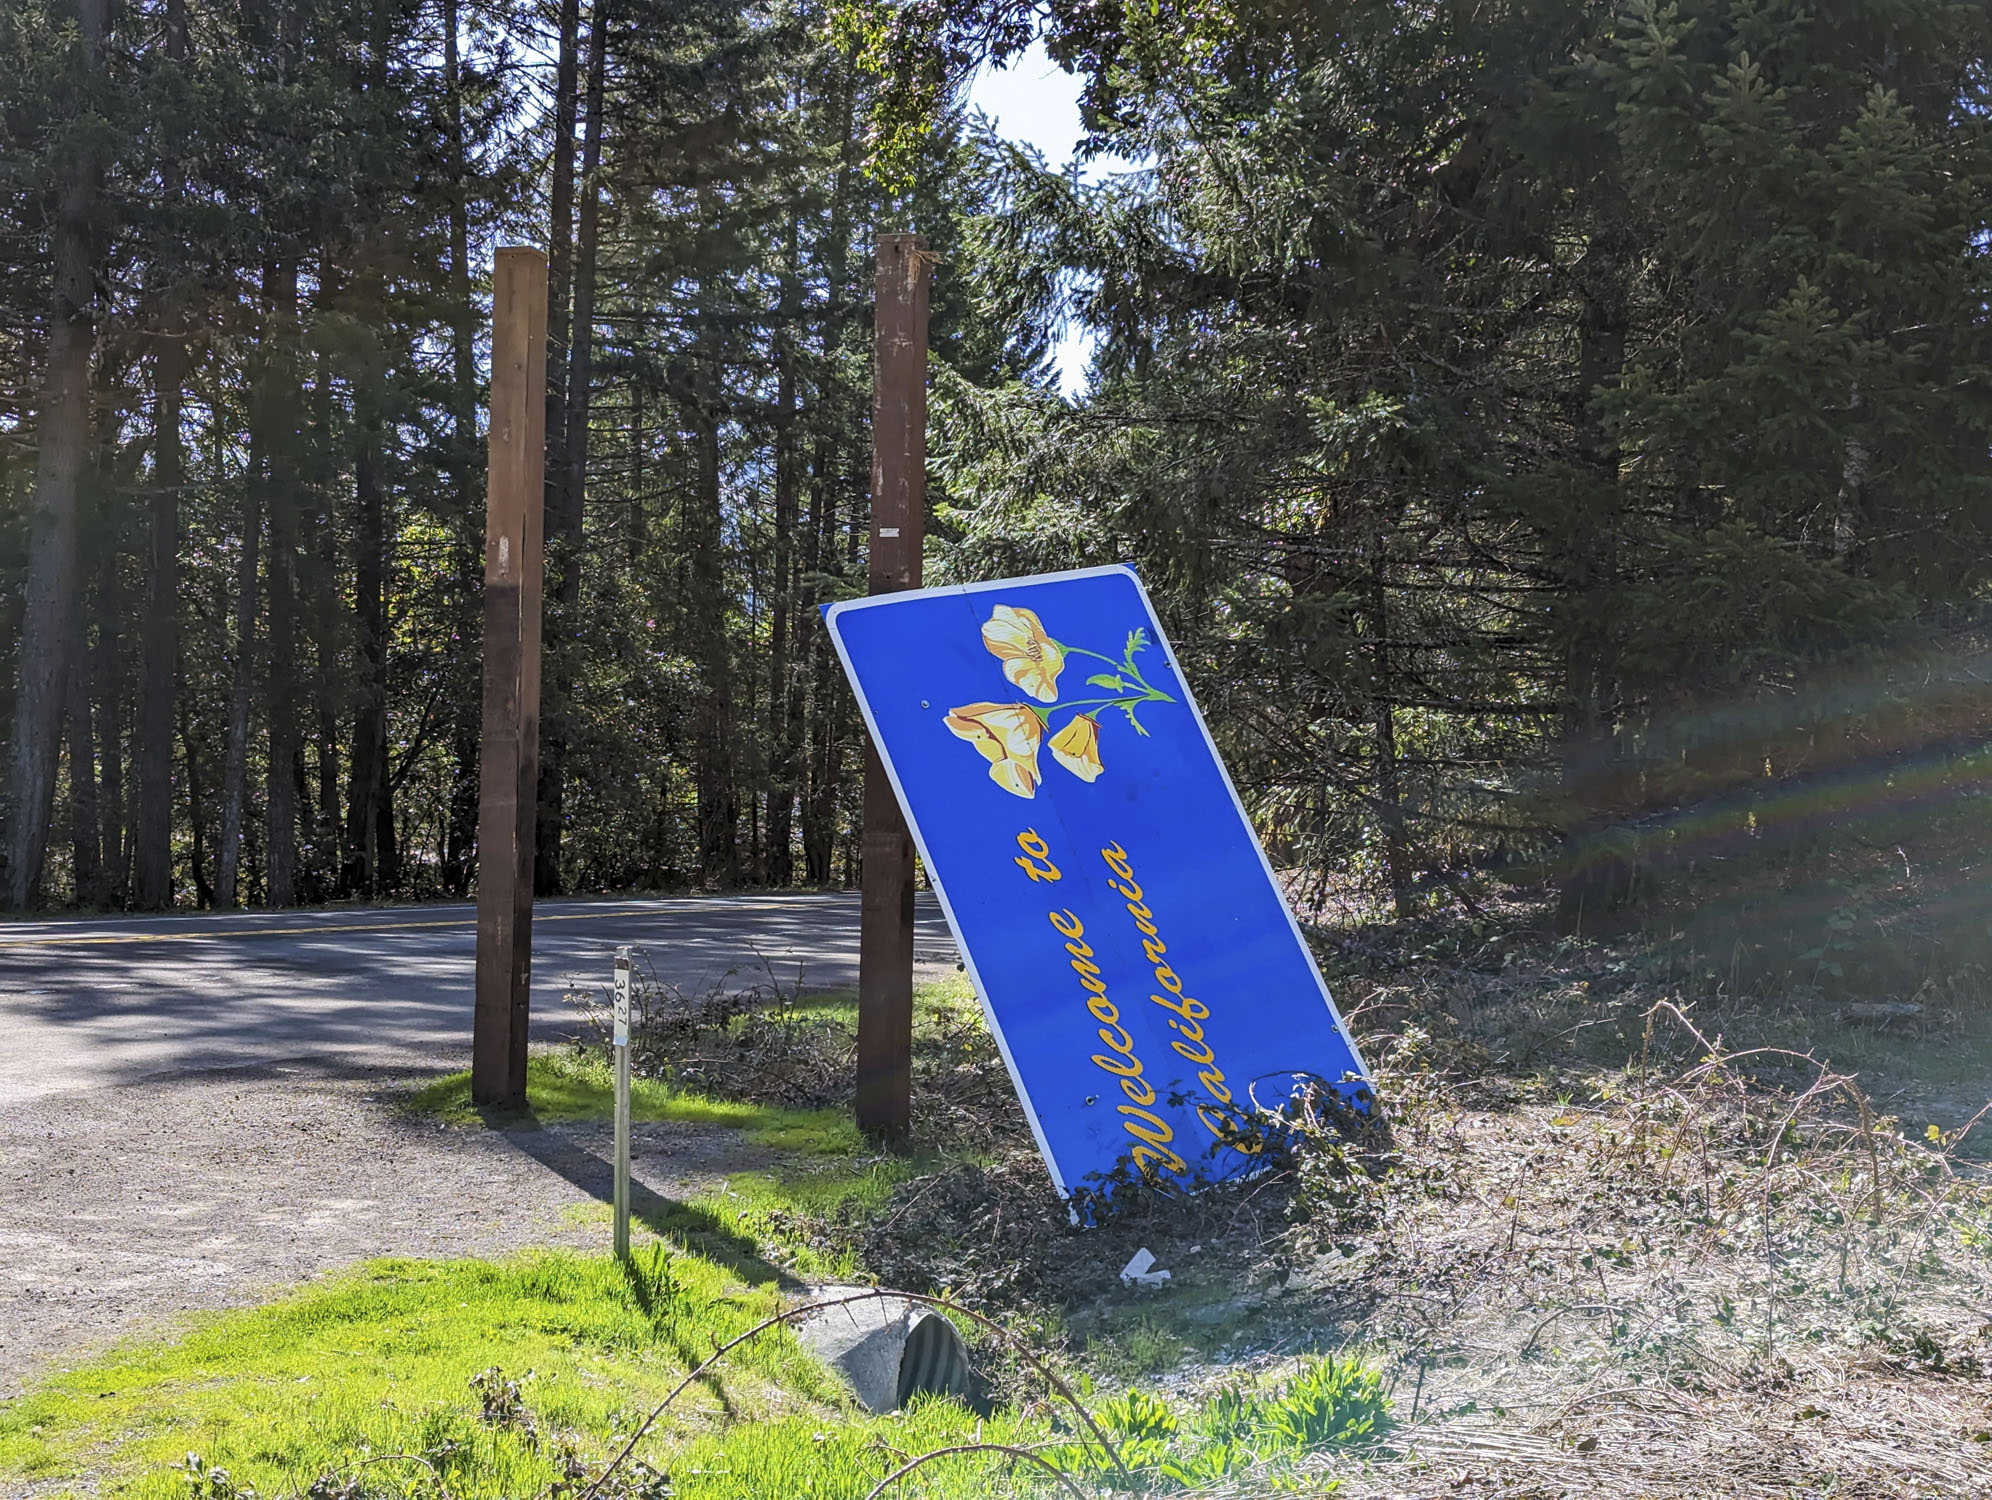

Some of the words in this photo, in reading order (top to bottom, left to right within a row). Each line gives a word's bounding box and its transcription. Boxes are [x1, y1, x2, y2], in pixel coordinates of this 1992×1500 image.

[1014, 827, 1062, 884] to
[1049, 908, 1187, 1186] Welcome
[1101, 840, 1263, 1155] California
